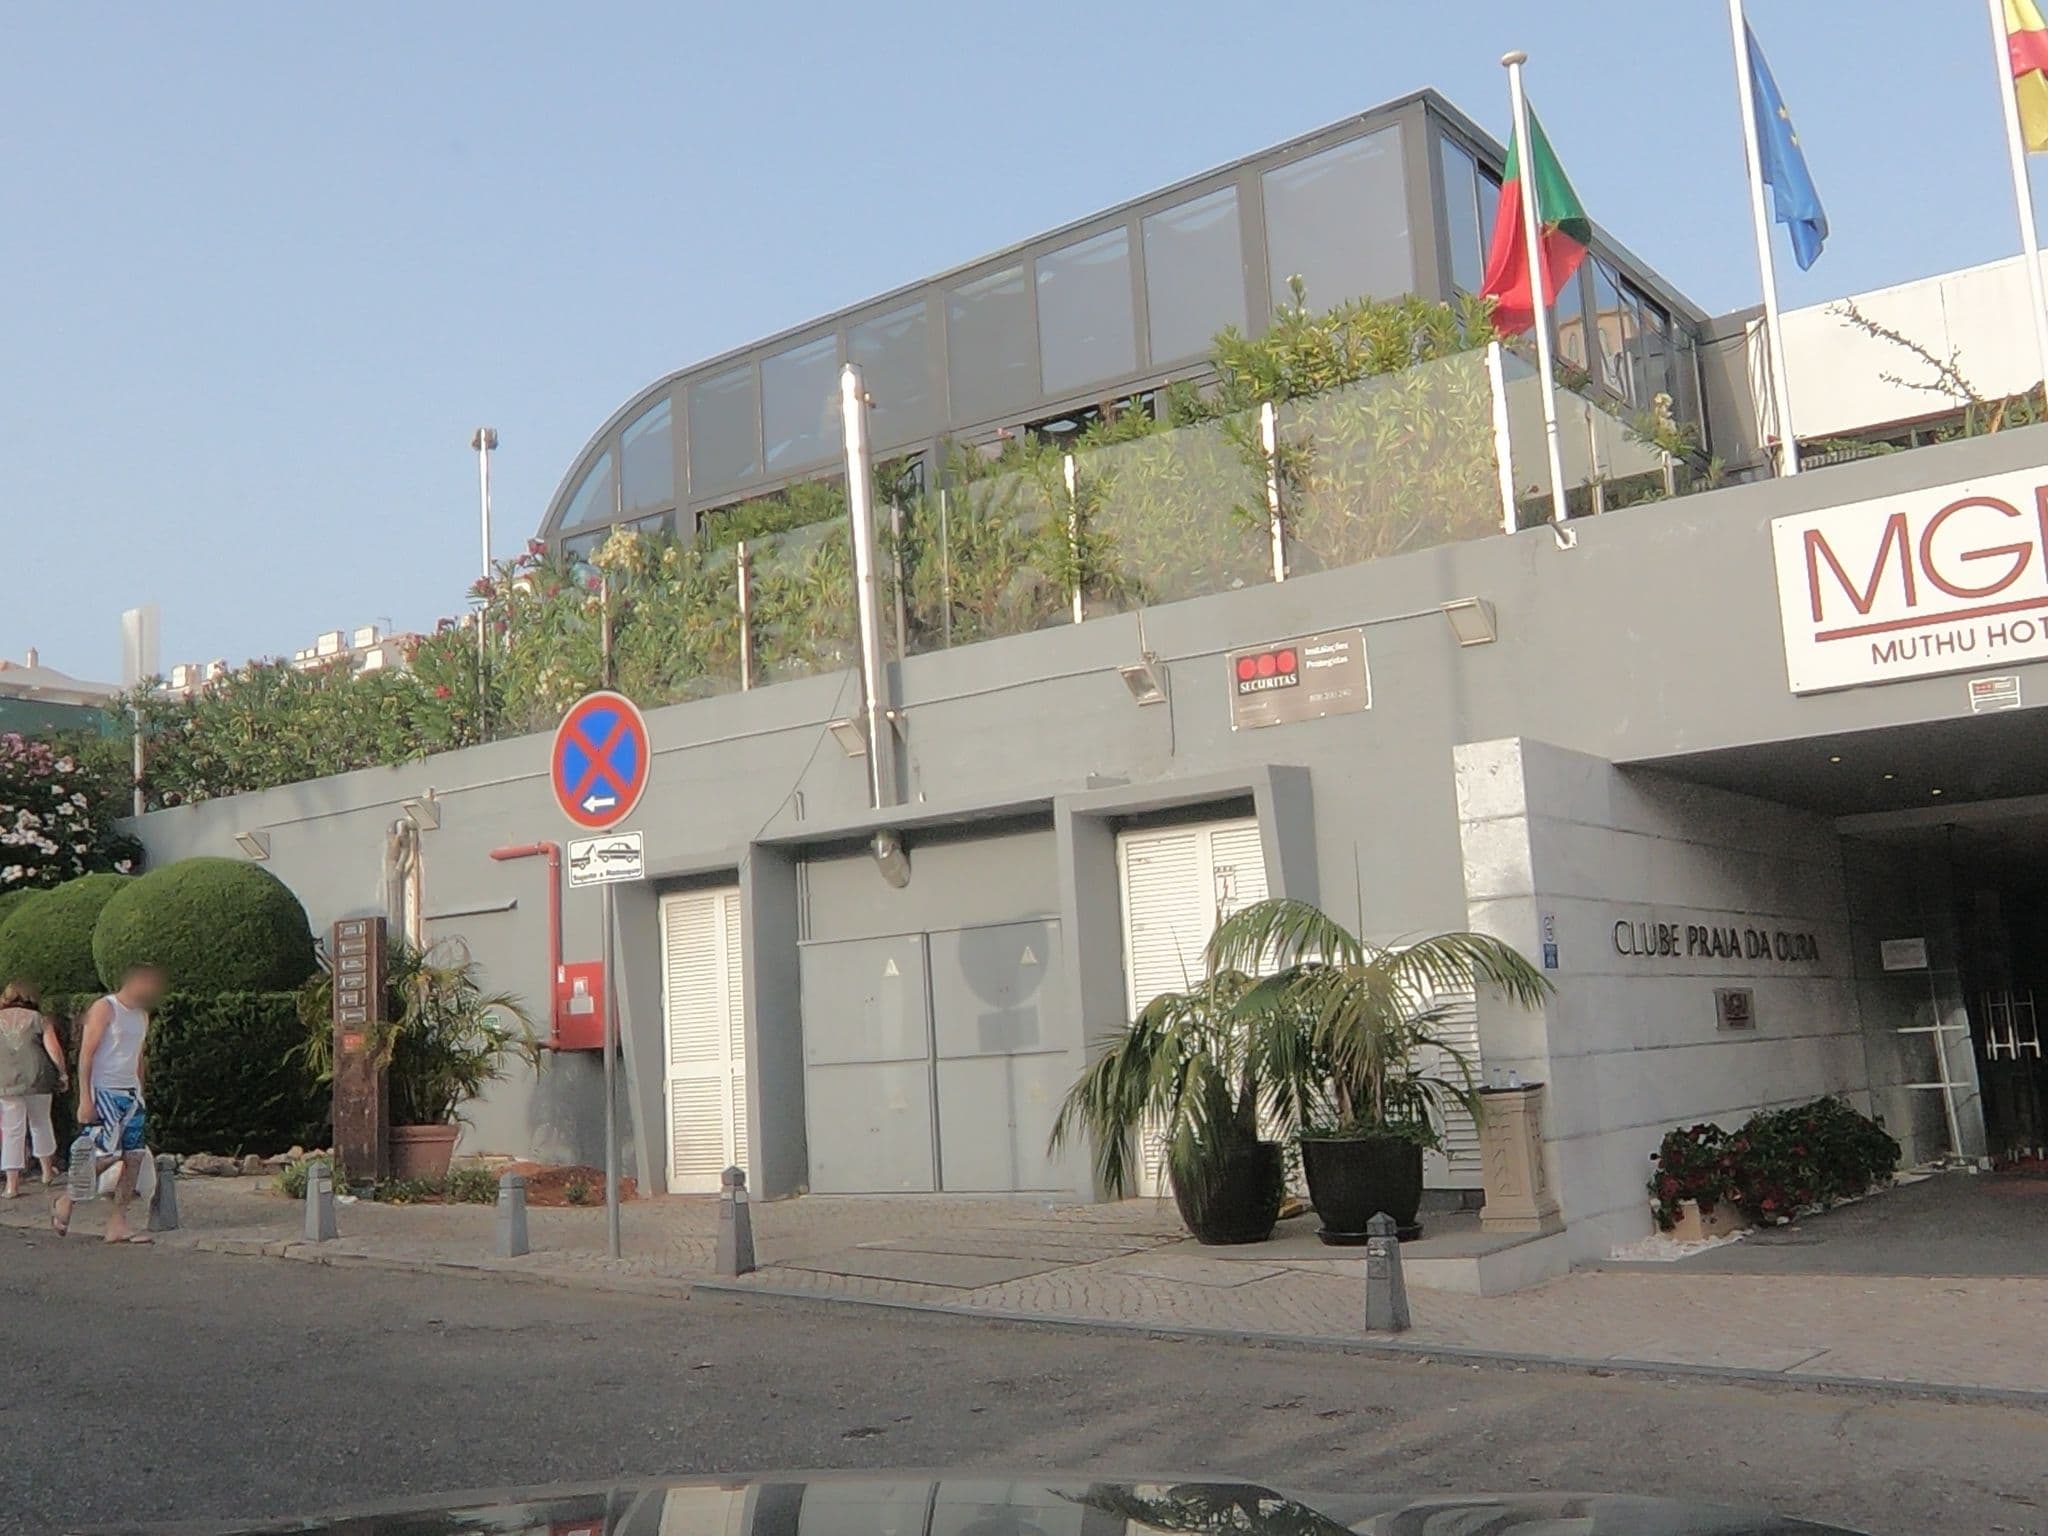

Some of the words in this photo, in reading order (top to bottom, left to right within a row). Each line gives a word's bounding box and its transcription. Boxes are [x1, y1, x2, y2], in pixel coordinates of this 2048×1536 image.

[1871, 628, 1976, 665] MUTHU
[1239, 673, 1297, 694] SECURITAS
[1613, 920, 1682, 957] CLUBE
[1686, 924, 1742, 959] PRAIA
[1744, 928, 1773, 960] DA
